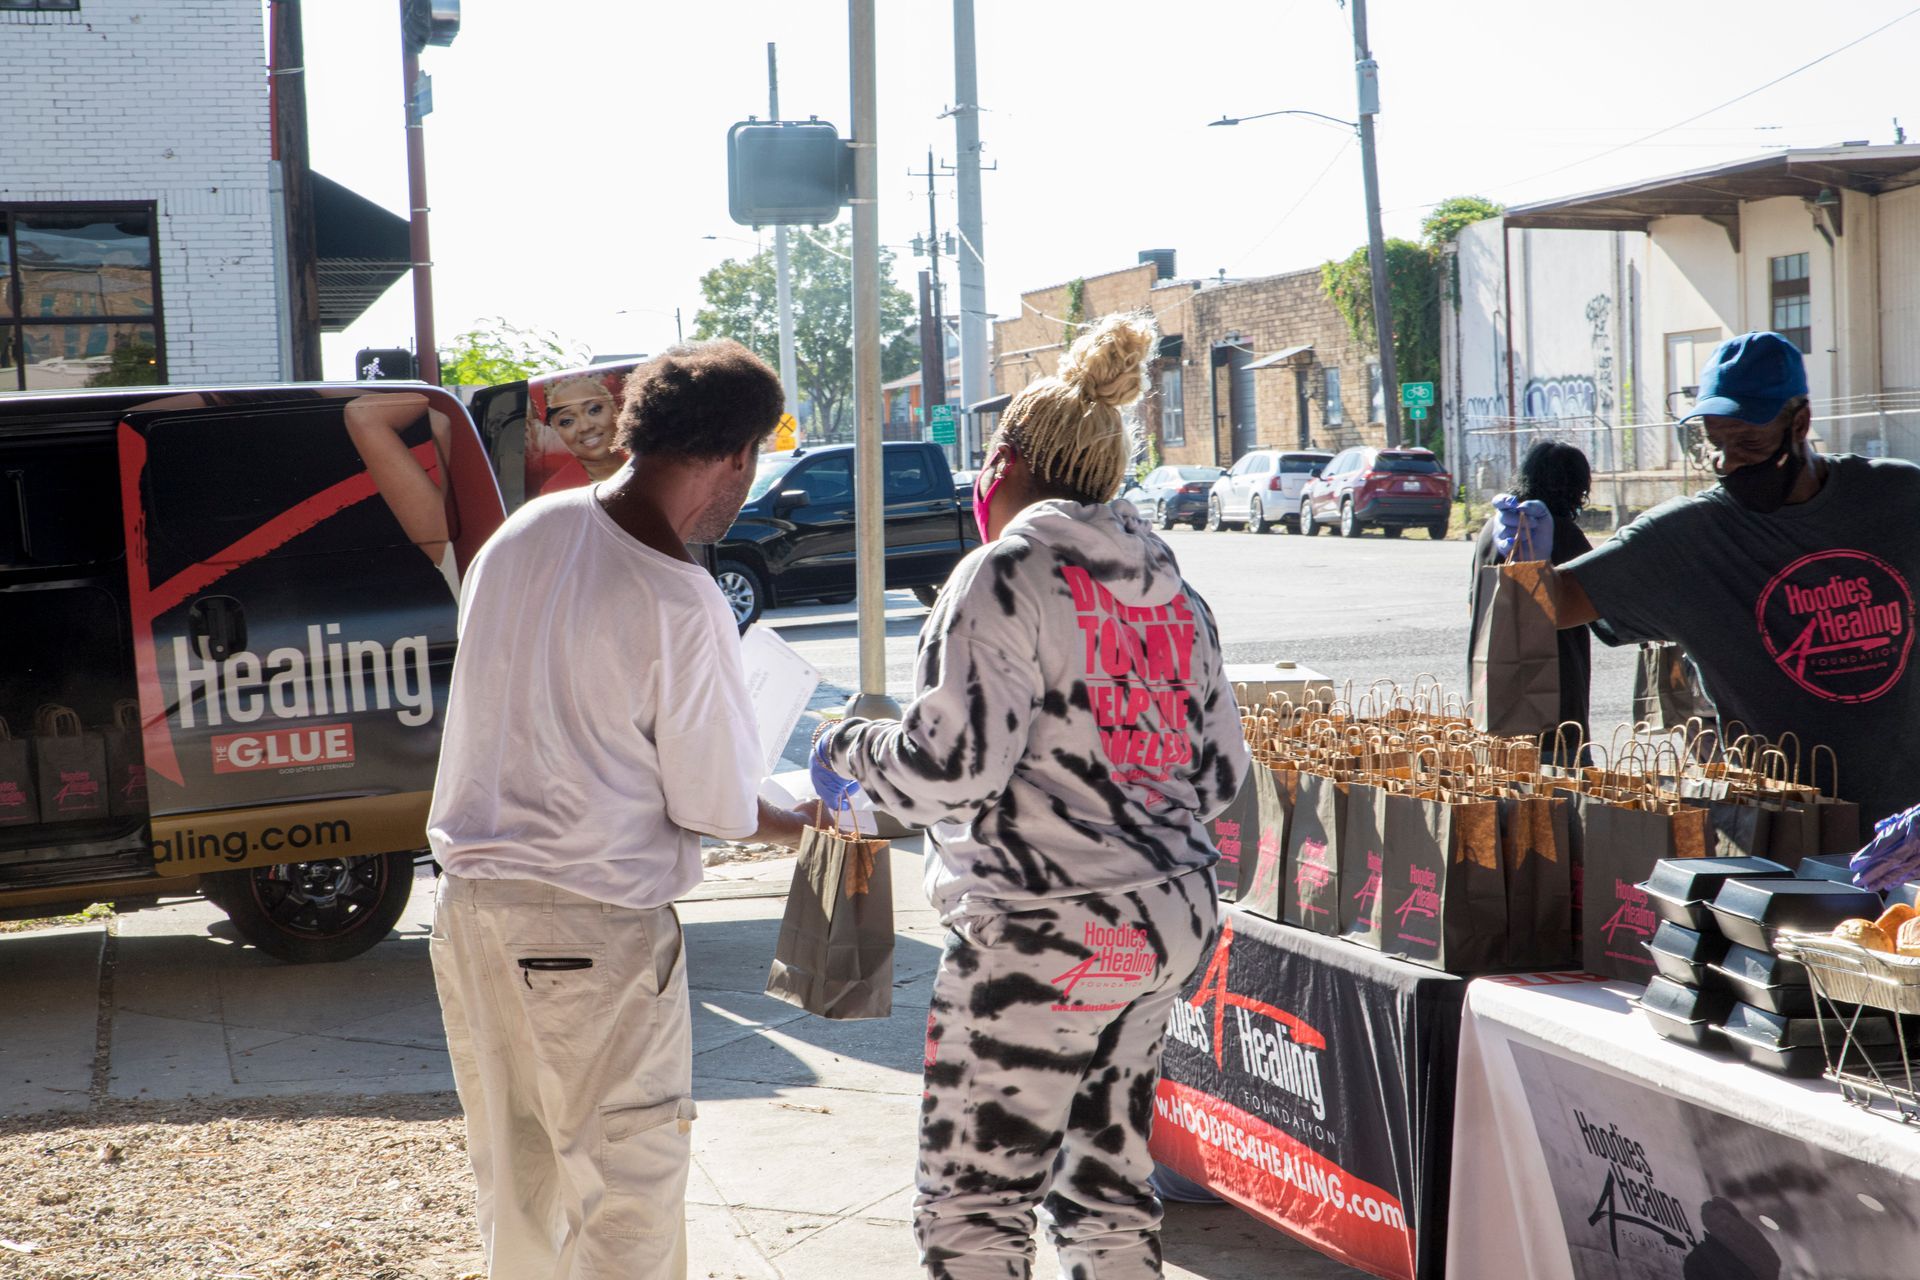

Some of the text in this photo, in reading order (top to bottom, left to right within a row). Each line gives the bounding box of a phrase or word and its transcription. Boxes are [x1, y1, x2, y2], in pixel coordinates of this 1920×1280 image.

[1784, 575, 1872, 615] Hoodies
[1817, 600, 1902, 643] Healing
[173, 623, 434, 728] Healing
[215, 728, 353, 768] THE G.L.U.E.
[1083, 921, 1147, 949] Hoodies
[1100, 946, 1158, 977] Healing
[1236, 1005, 1326, 1121] Healing
[1245, 1091, 1337, 1145] FOUNDATION
[1573, 1108, 1654, 1178] Hoodies
[1610, 1161, 1698, 1248] Healing
